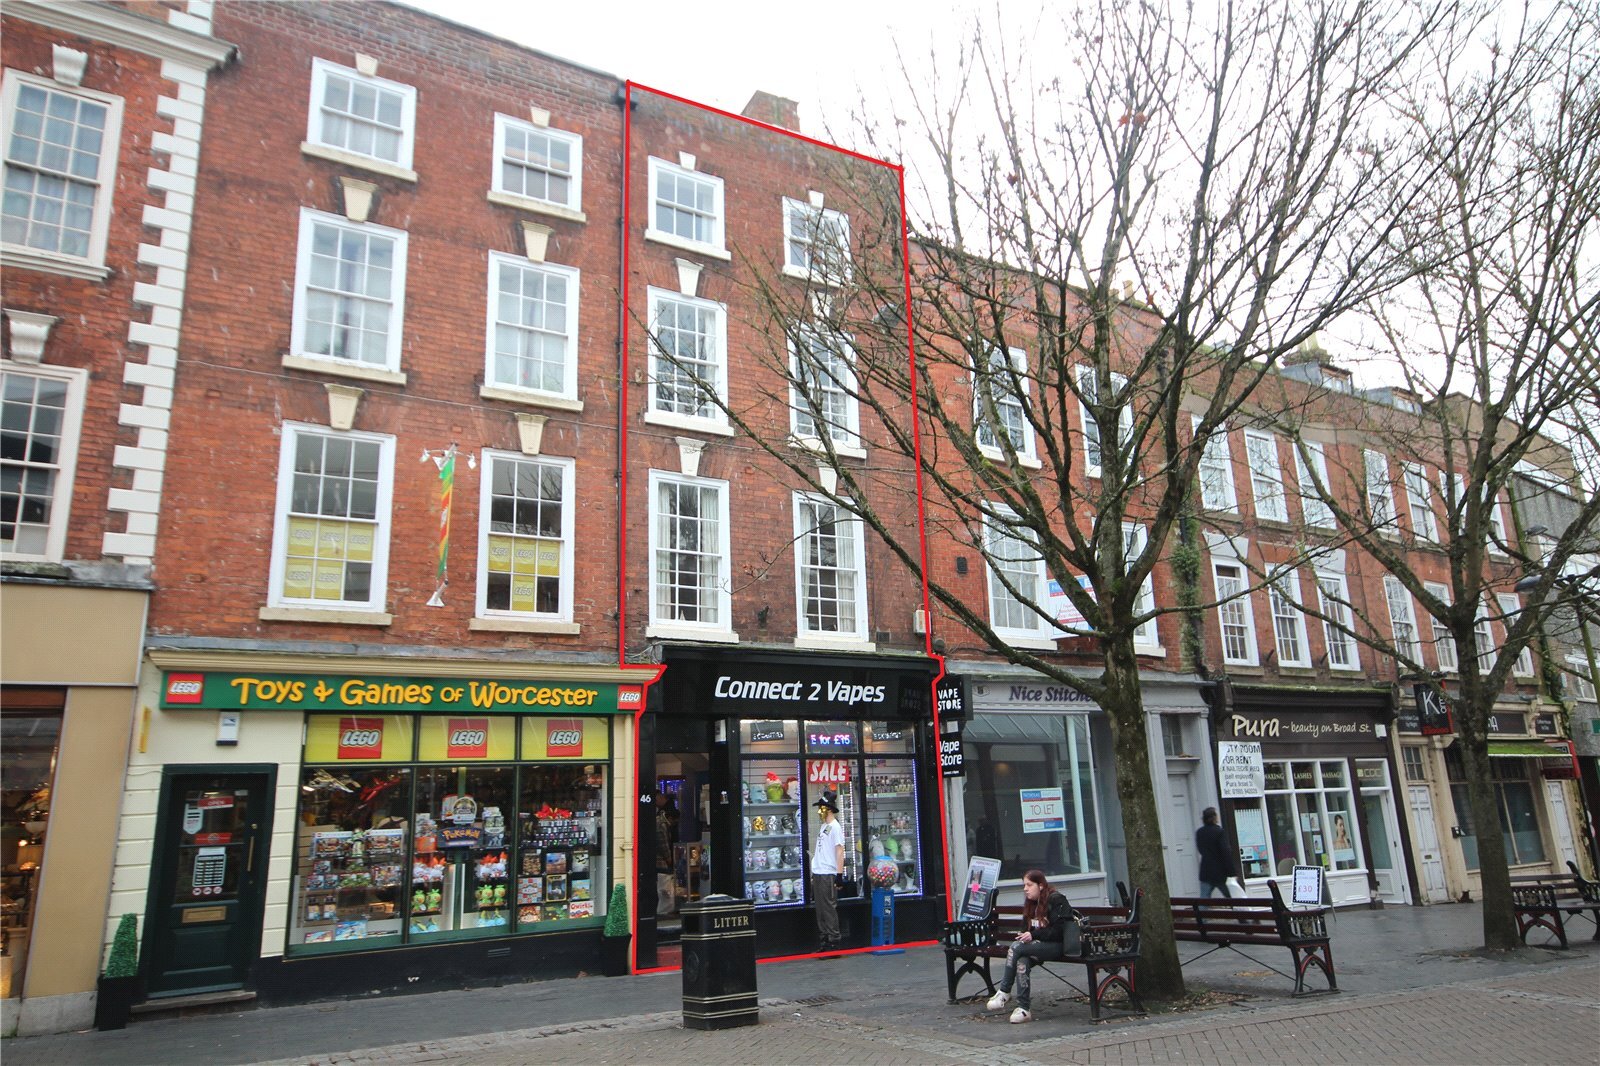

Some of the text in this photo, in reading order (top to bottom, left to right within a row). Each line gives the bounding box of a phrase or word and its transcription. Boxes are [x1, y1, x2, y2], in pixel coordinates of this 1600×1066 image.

[491, 547, 509, 556] LEGO
[515, 549, 534, 559] LEGO
[540, 551, 558, 561] LEGO
[515, 586, 532, 596] LEGO
[168, 680, 202, 694] LEGO
[230, 677, 306, 704] Toys
[313, 680, 335, 703] &
[340, 680, 434, 705] Games
[468, 680, 599, 708] Worcester
[714, 676, 803, 700] Connect
[808, 683, 821, 701] 2
[826, 680, 886, 706] Vapes
[938, 688, 958, 700] VAPE
[1009, 685, 1094, 703] Nice Stitche
[620, 691, 641, 702] LEGO
[938, 699, 961, 711] STORE
[1231, 714, 1280, 738] Pura
[1290, 721, 1319, 738] beauty
[1320, 724, 1333, 732] on
[1333, 721, 1357, 733] Broad
[340, 729, 382, 747] LEGO
[449, 728, 487, 747] LEGO
[547, 728, 583, 746] LEGO
[940, 740, 960, 754] Vape
[940, 753, 963, 767] Store
[809, 760, 848, 782] SALE
[639, 794, 652, 803] 46
[1030, 804, 1054, 816] TO LET
[713, 915, 749, 929] LITTER
